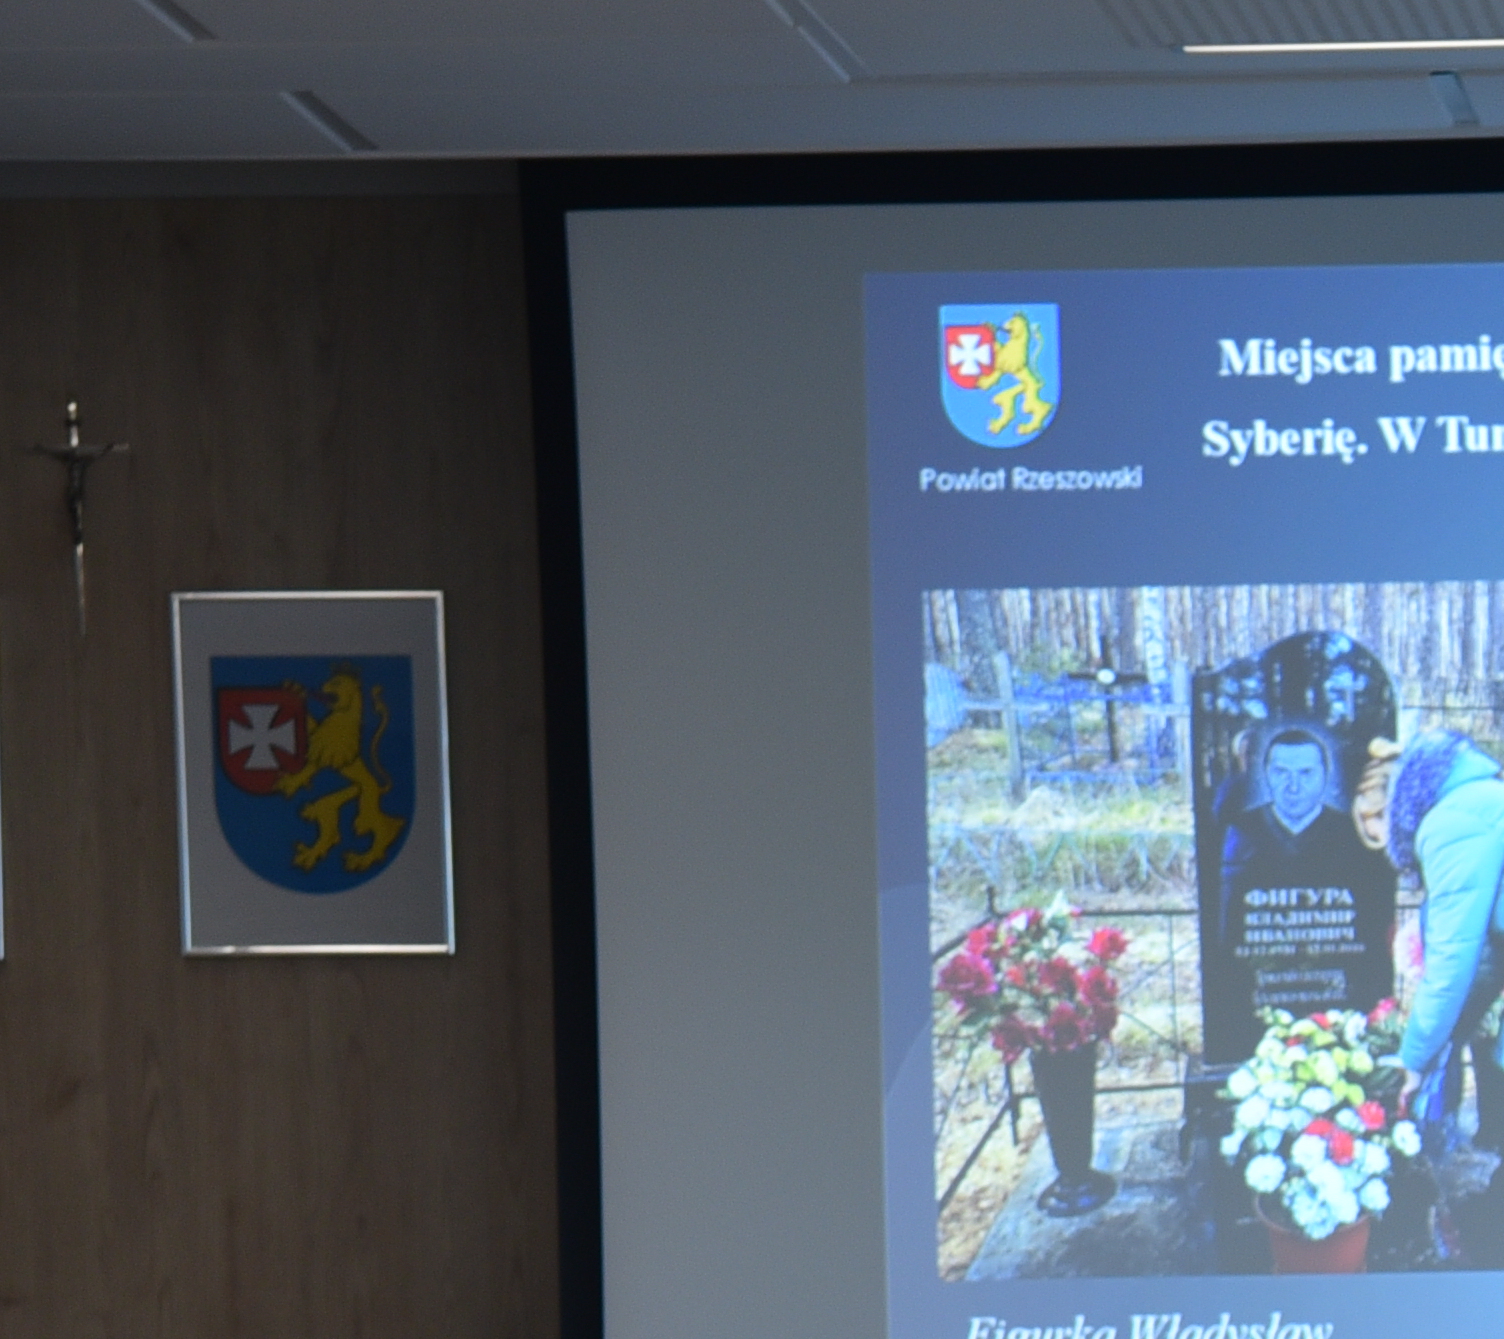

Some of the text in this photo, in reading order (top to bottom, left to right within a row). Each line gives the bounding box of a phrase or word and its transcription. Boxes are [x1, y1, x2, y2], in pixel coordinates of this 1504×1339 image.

[1219, 338, 1377, 385] Miejsca
[1202, 418, 1368, 467] Syberię.
[1377, 416, 1426, 453] W
[919, 465, 1143, 492] Powiat Rzeszowski
